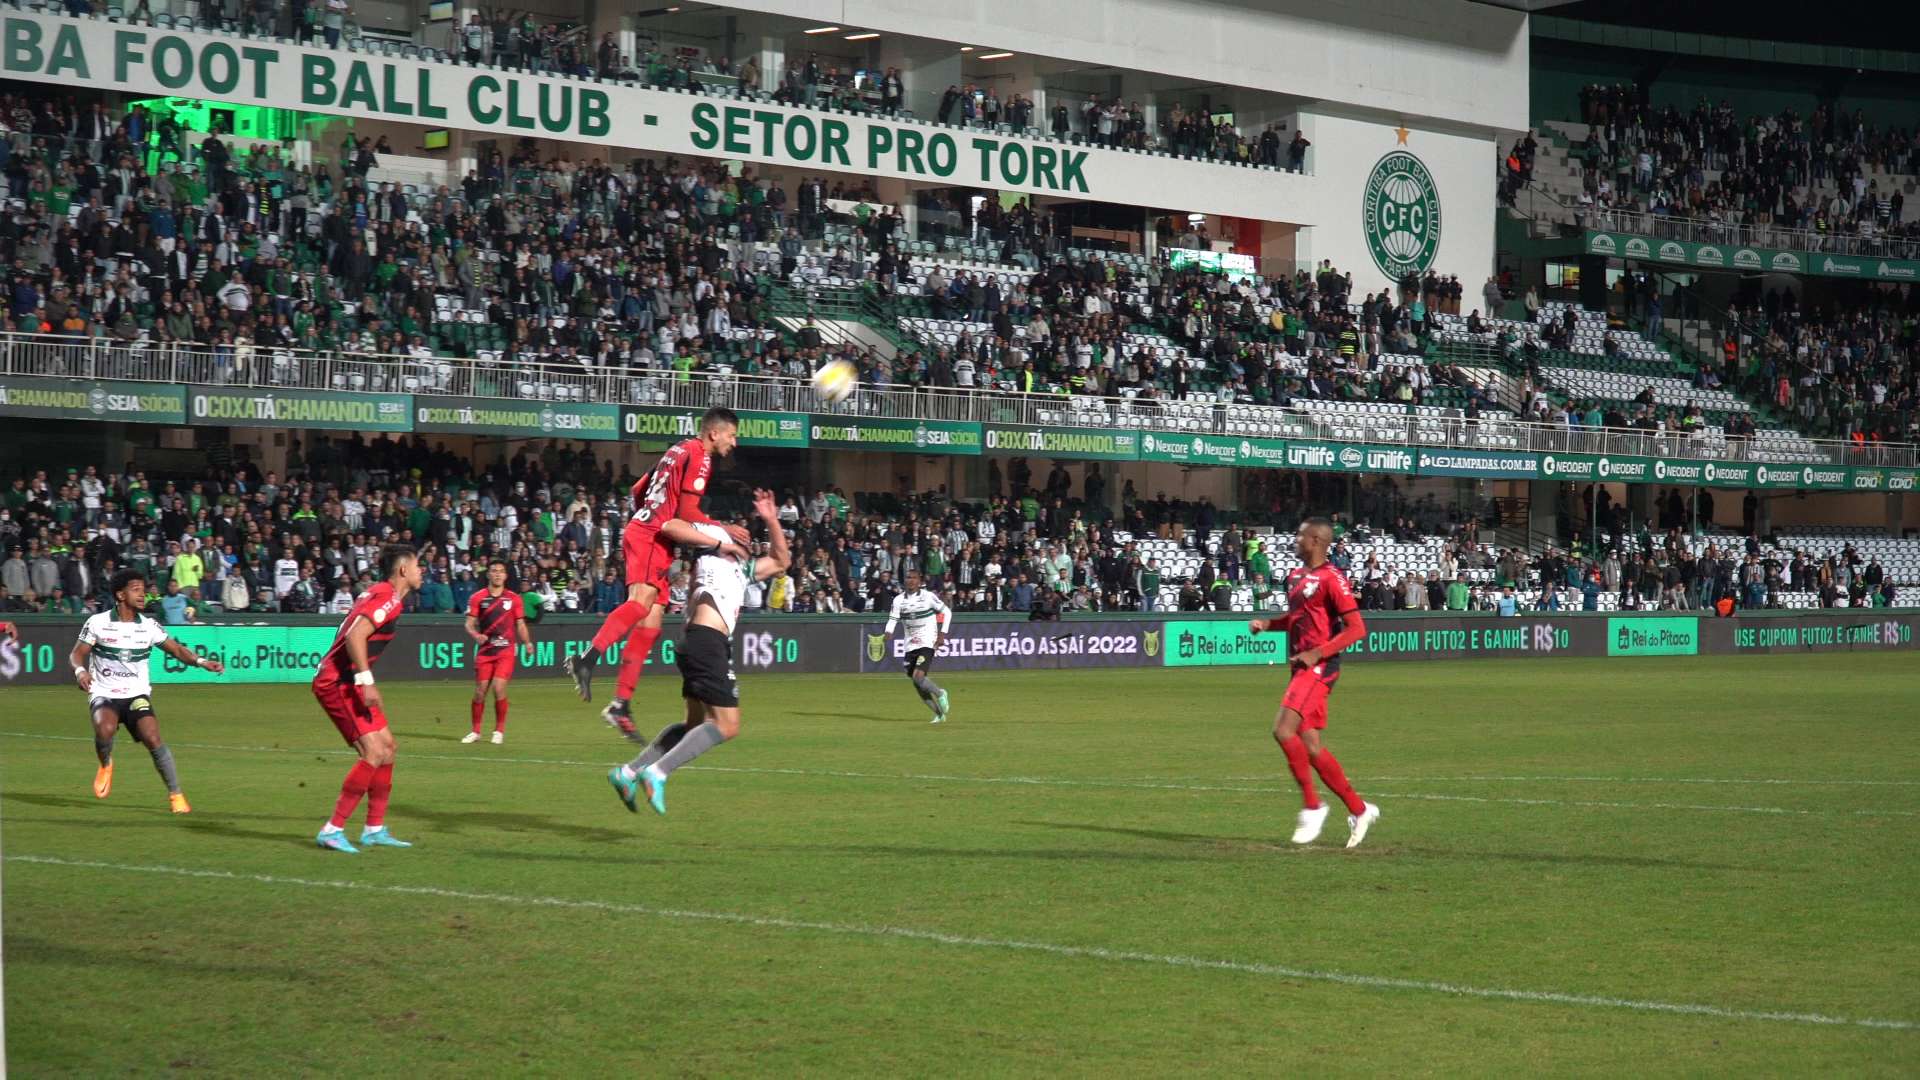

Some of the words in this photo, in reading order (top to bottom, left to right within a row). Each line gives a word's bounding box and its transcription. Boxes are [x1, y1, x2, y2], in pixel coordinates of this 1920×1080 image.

[3, 18, 91, 79] BA
[114, 30, 279, 98] FOOT
[301, 53, 448, 119] BALL
[467, 75, 612, 137] CLUB
[690, 102, 852, 167] SETOR
[867, 127, 958, 177] PRO
[973, 138, 1090, 193] TORK
[1366, 168, 1388, 233] CORITIBA
[1386, 157, 1412, 173] FOOT
[1412, 164, 1432, 198] BALL
[1428, 200, 1438, 241] CLUB
[1382, 201, 1424, 234] CFC
[1155, 440, 1189, 454] Nexcore
[1203, 443, 1236, 457] Nexcore
[1251, 445, 1283, 459] Nexcore
[1288, 446, 1335, 466] unilife
[1367, 450, 1412, 470] unilife
[1556, 462, 1595, 473] NEODENT
[1610, 464, 1646, 475] NEODENT
[1666, 466, 1700, 477] NEODENT
[1715, 468, 1748, 480] NEODENT
[1767, 471, 1799, 481] NEODENT
[1813, 471, 1846, 483] NEODENT
[893, 632, 1034, 658] BSILEIRÃO
[1038, 634, 1084, 654] ASSAÍ
[1088, 635, 1137, 654] 2022
[1198, 635, 1217, 654] Rei
[1219, 640, 1233, 654] do
[1235, 635, 1276, 654] Pitaco
[1369, 631, 1419, 652] CUPOM
[1471, 629, 1478, 649] E
[1484, 625, 1528, 649] GANHE
[1632, 630, 1647, 647] Rei
[1648, 633, 1659, 647] do
[1659, 630, 1690, 646] Pitaco
[1734, 628, 1755, 647] USE
[1759, 627, 1797, 647] CUPOM
[1837, 626, 1843, 644] E
[230, 650, 252, 669] do
[256, 644, 324, 669] Pitaco
[419, 642, 465, 669] USE
